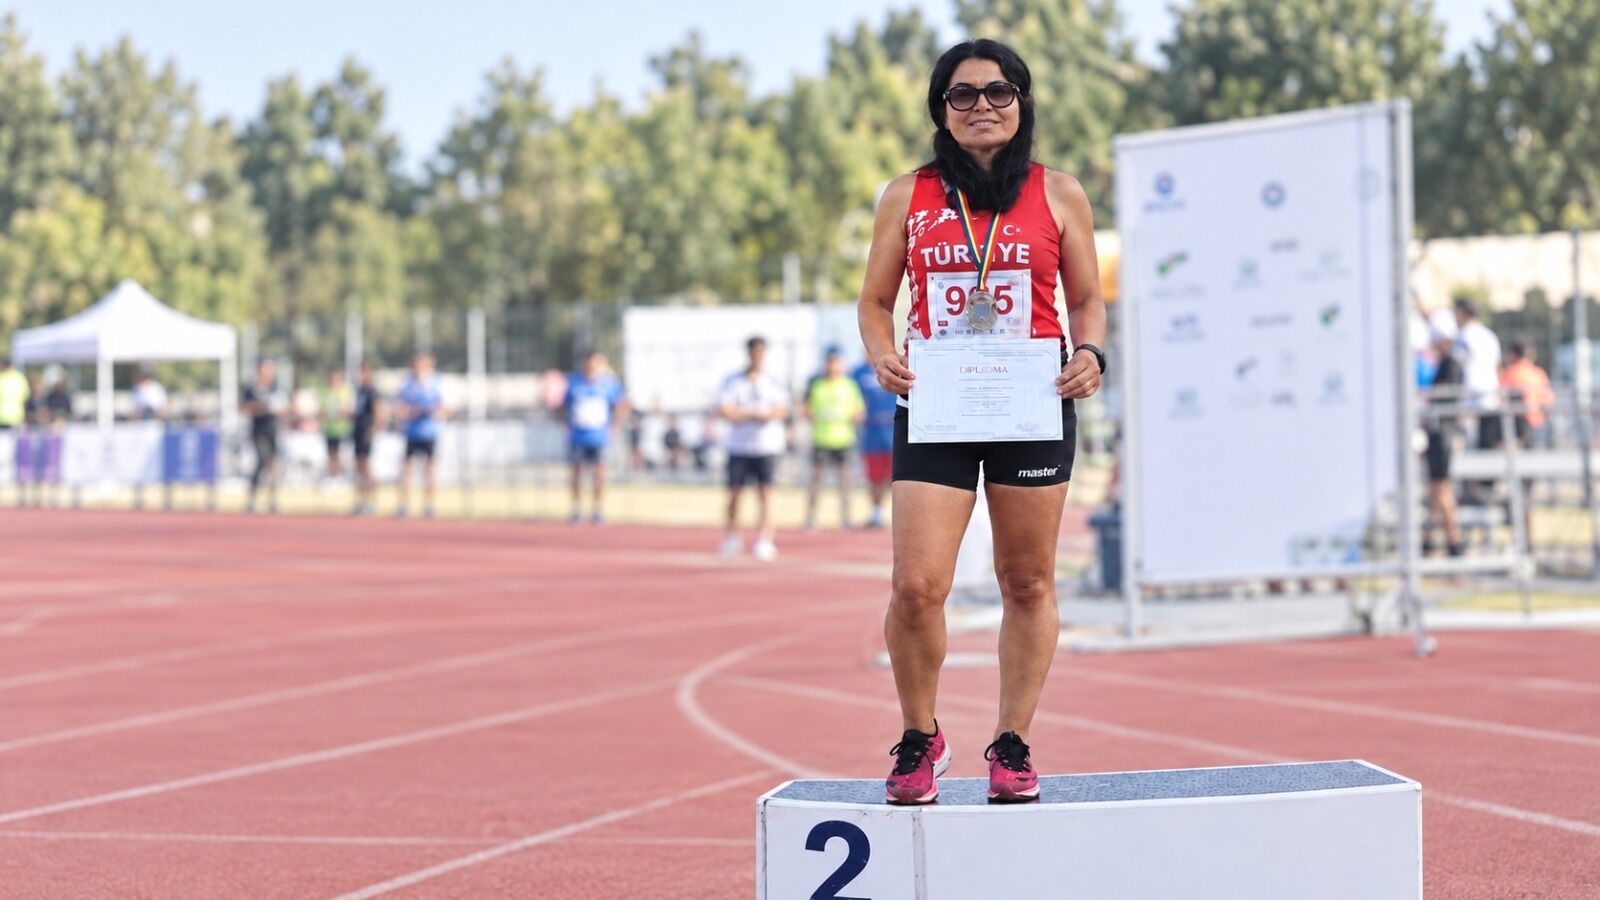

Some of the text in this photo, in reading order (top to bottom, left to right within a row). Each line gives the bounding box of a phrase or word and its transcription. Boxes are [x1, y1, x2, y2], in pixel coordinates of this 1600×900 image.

[921, 242, 1030, 267] TÜRYE
[945, 285, 1014, 316] 95
[1018, 467, 1058, 477] master
[805, 820, 872, 900] 2
